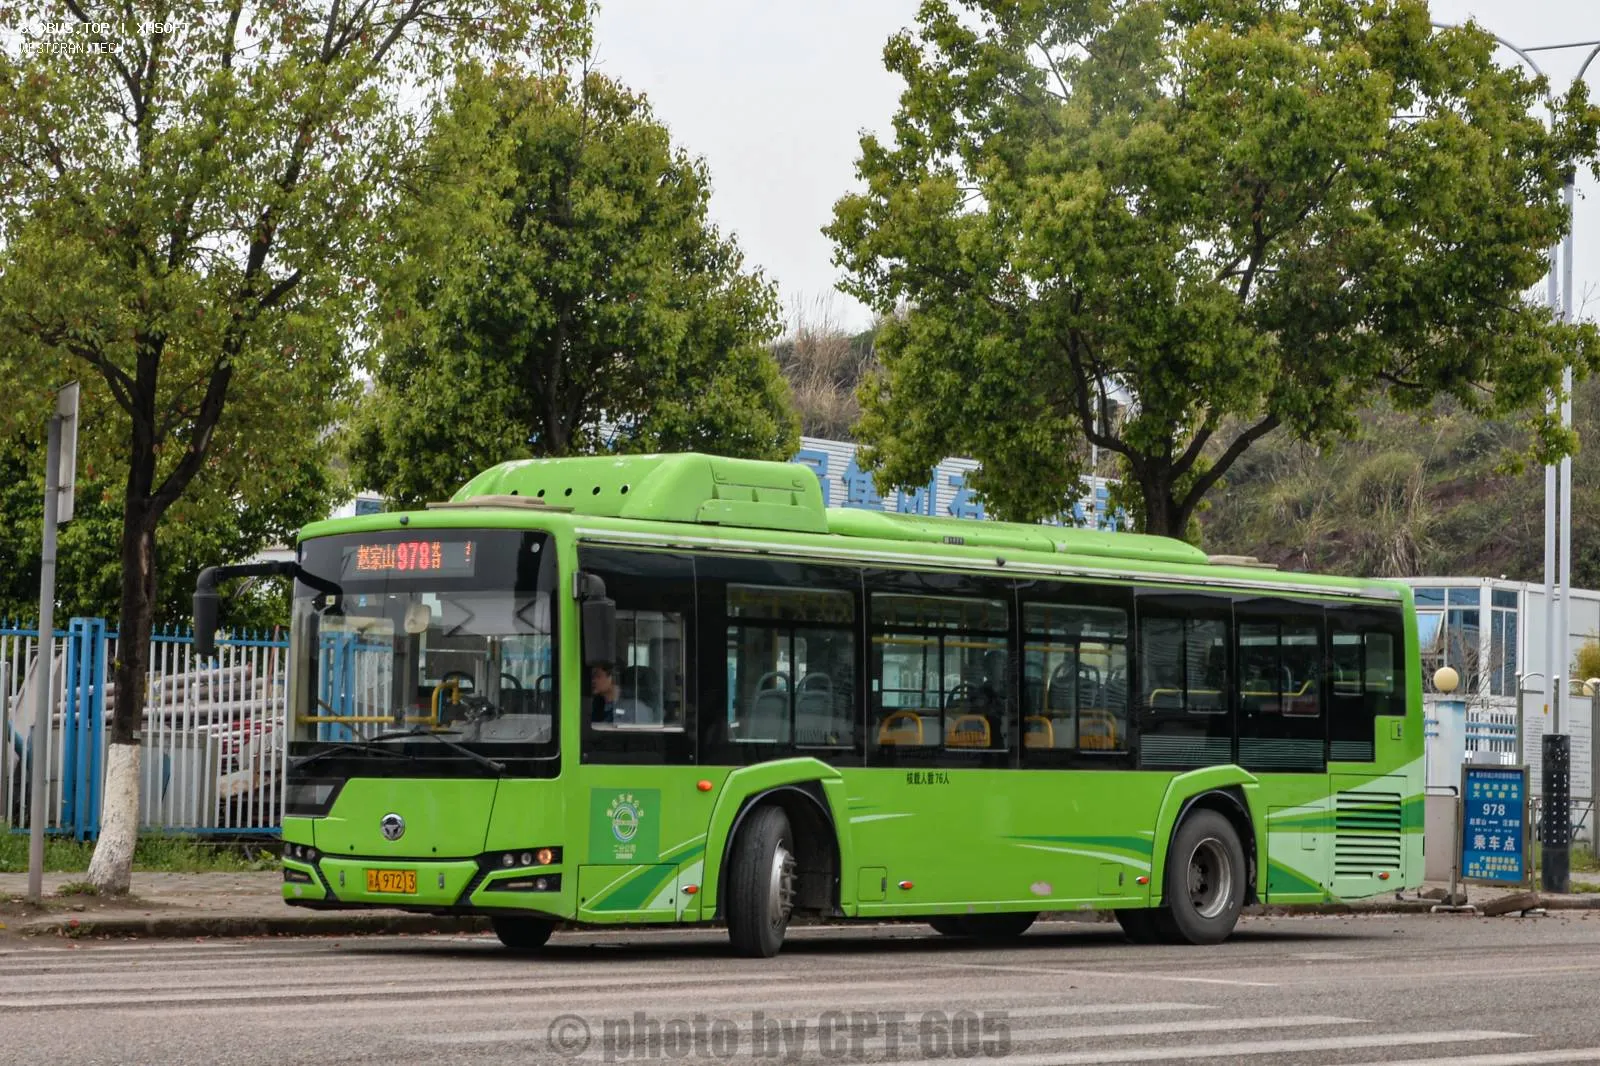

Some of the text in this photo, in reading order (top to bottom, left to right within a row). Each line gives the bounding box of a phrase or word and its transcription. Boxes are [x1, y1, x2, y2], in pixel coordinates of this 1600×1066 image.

[397, 541, 430, 570] 978
[1482, 803, 1506, 816] 978
[1473, 835, 1516, 851] 乘车点
